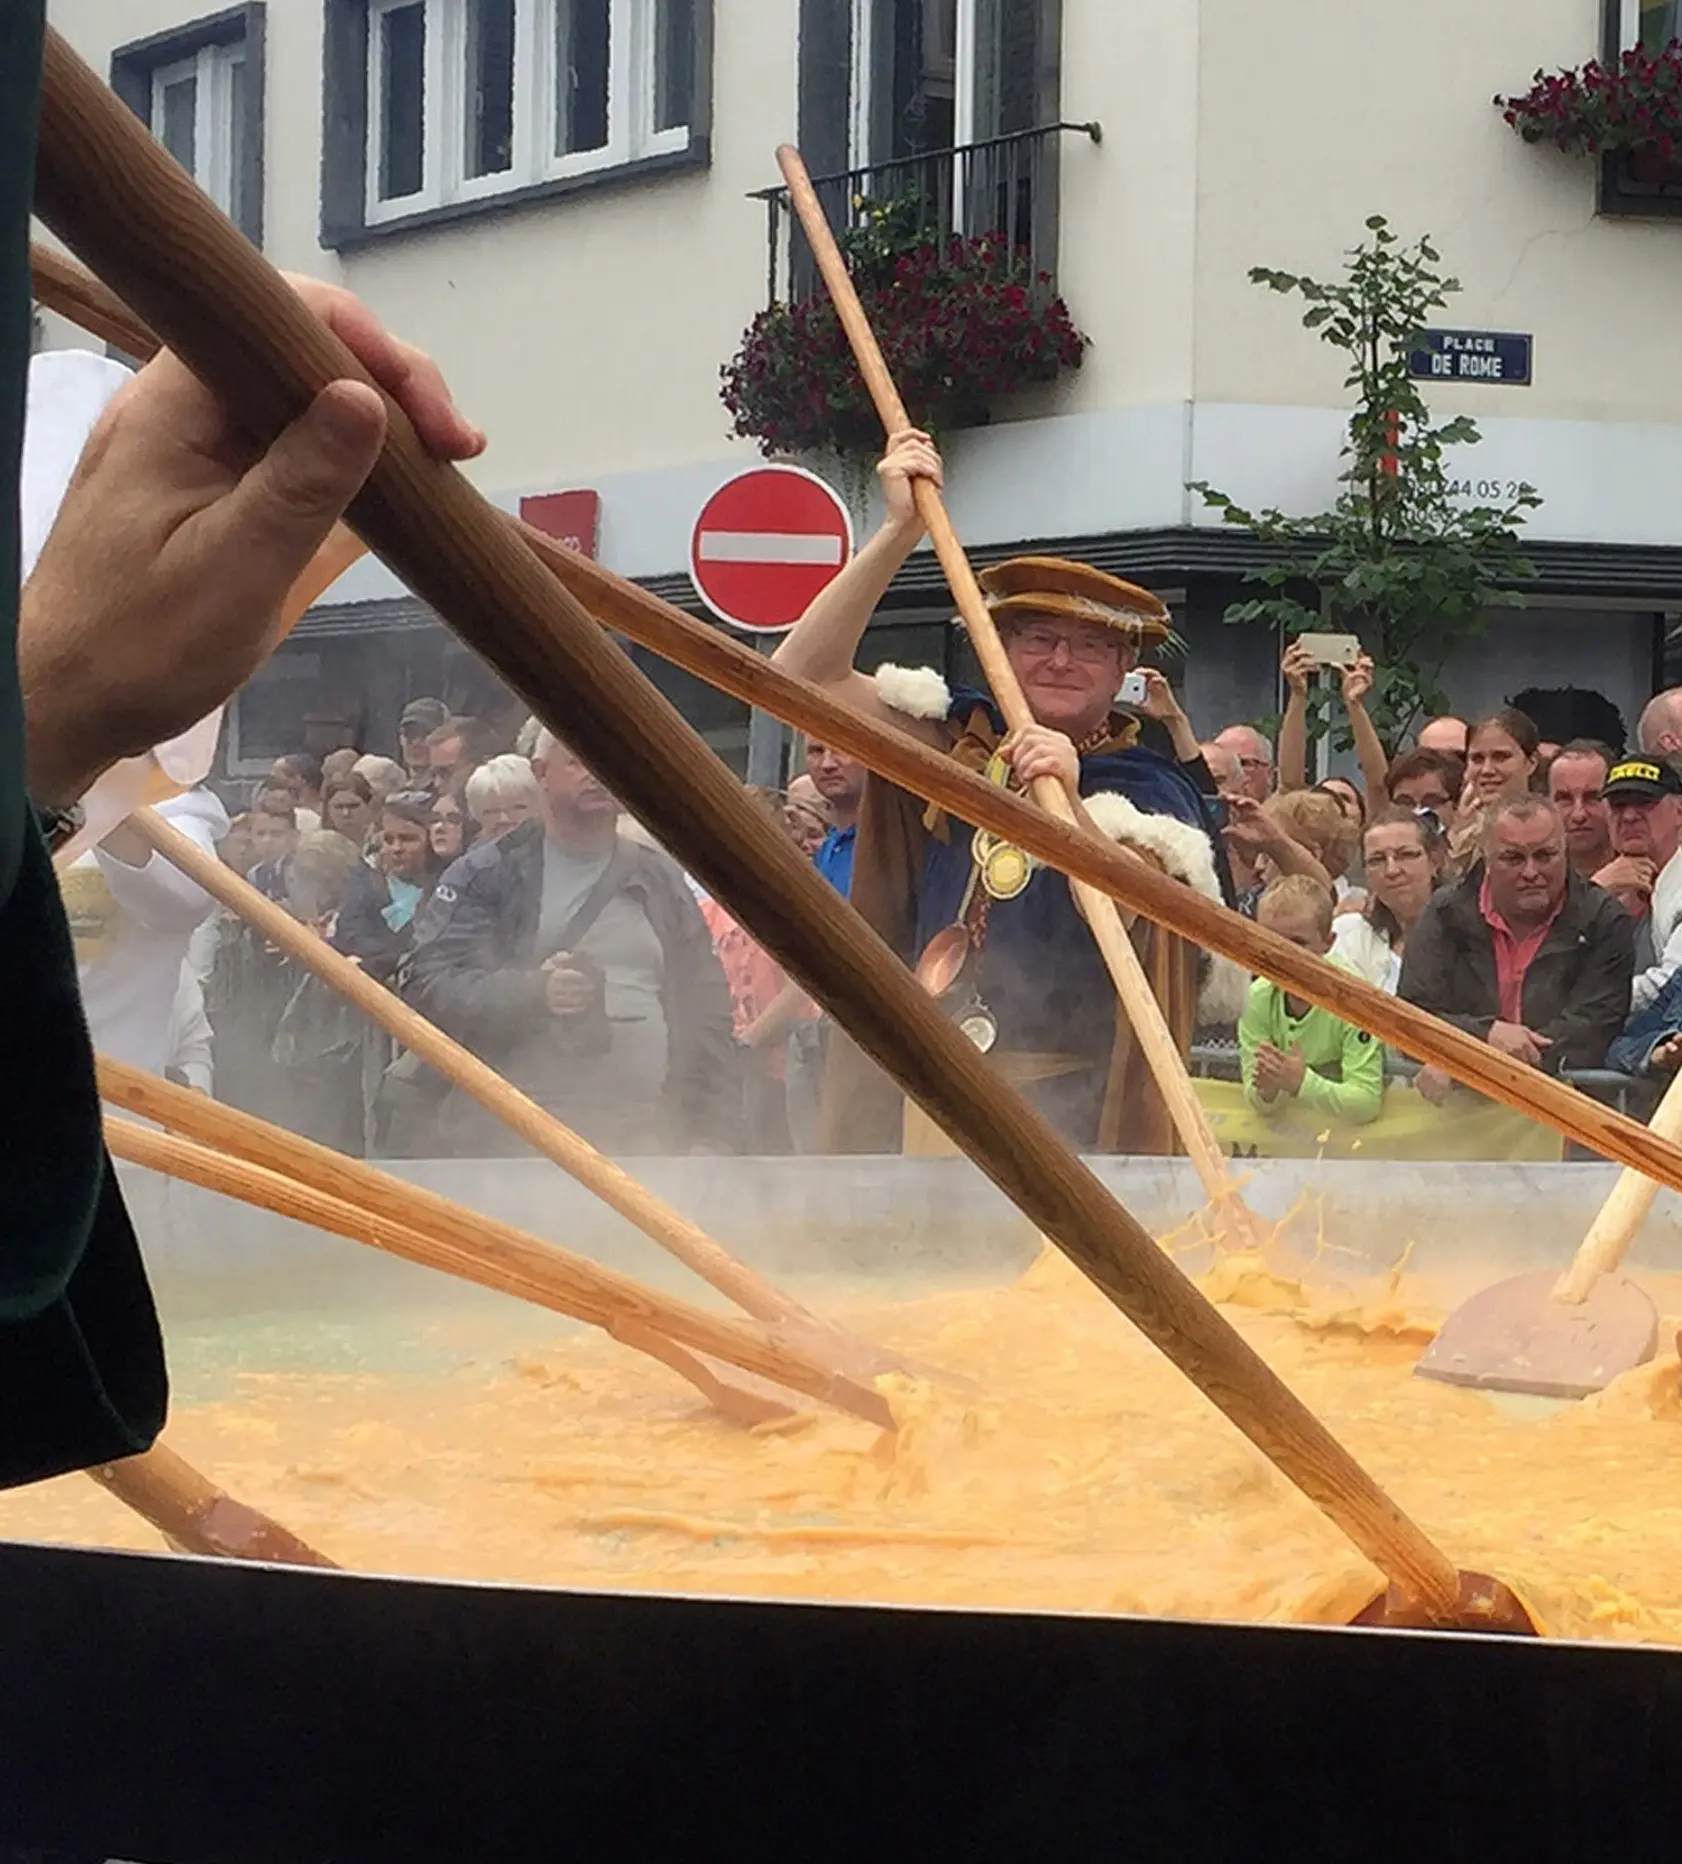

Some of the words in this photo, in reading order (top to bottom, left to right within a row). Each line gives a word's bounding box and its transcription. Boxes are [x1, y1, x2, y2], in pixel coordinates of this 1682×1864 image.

[1443, 336, 1495, 352] PLACE
[1431, 353, 1453, 375] DE
[1459, 355, 1503, 377] ROME
